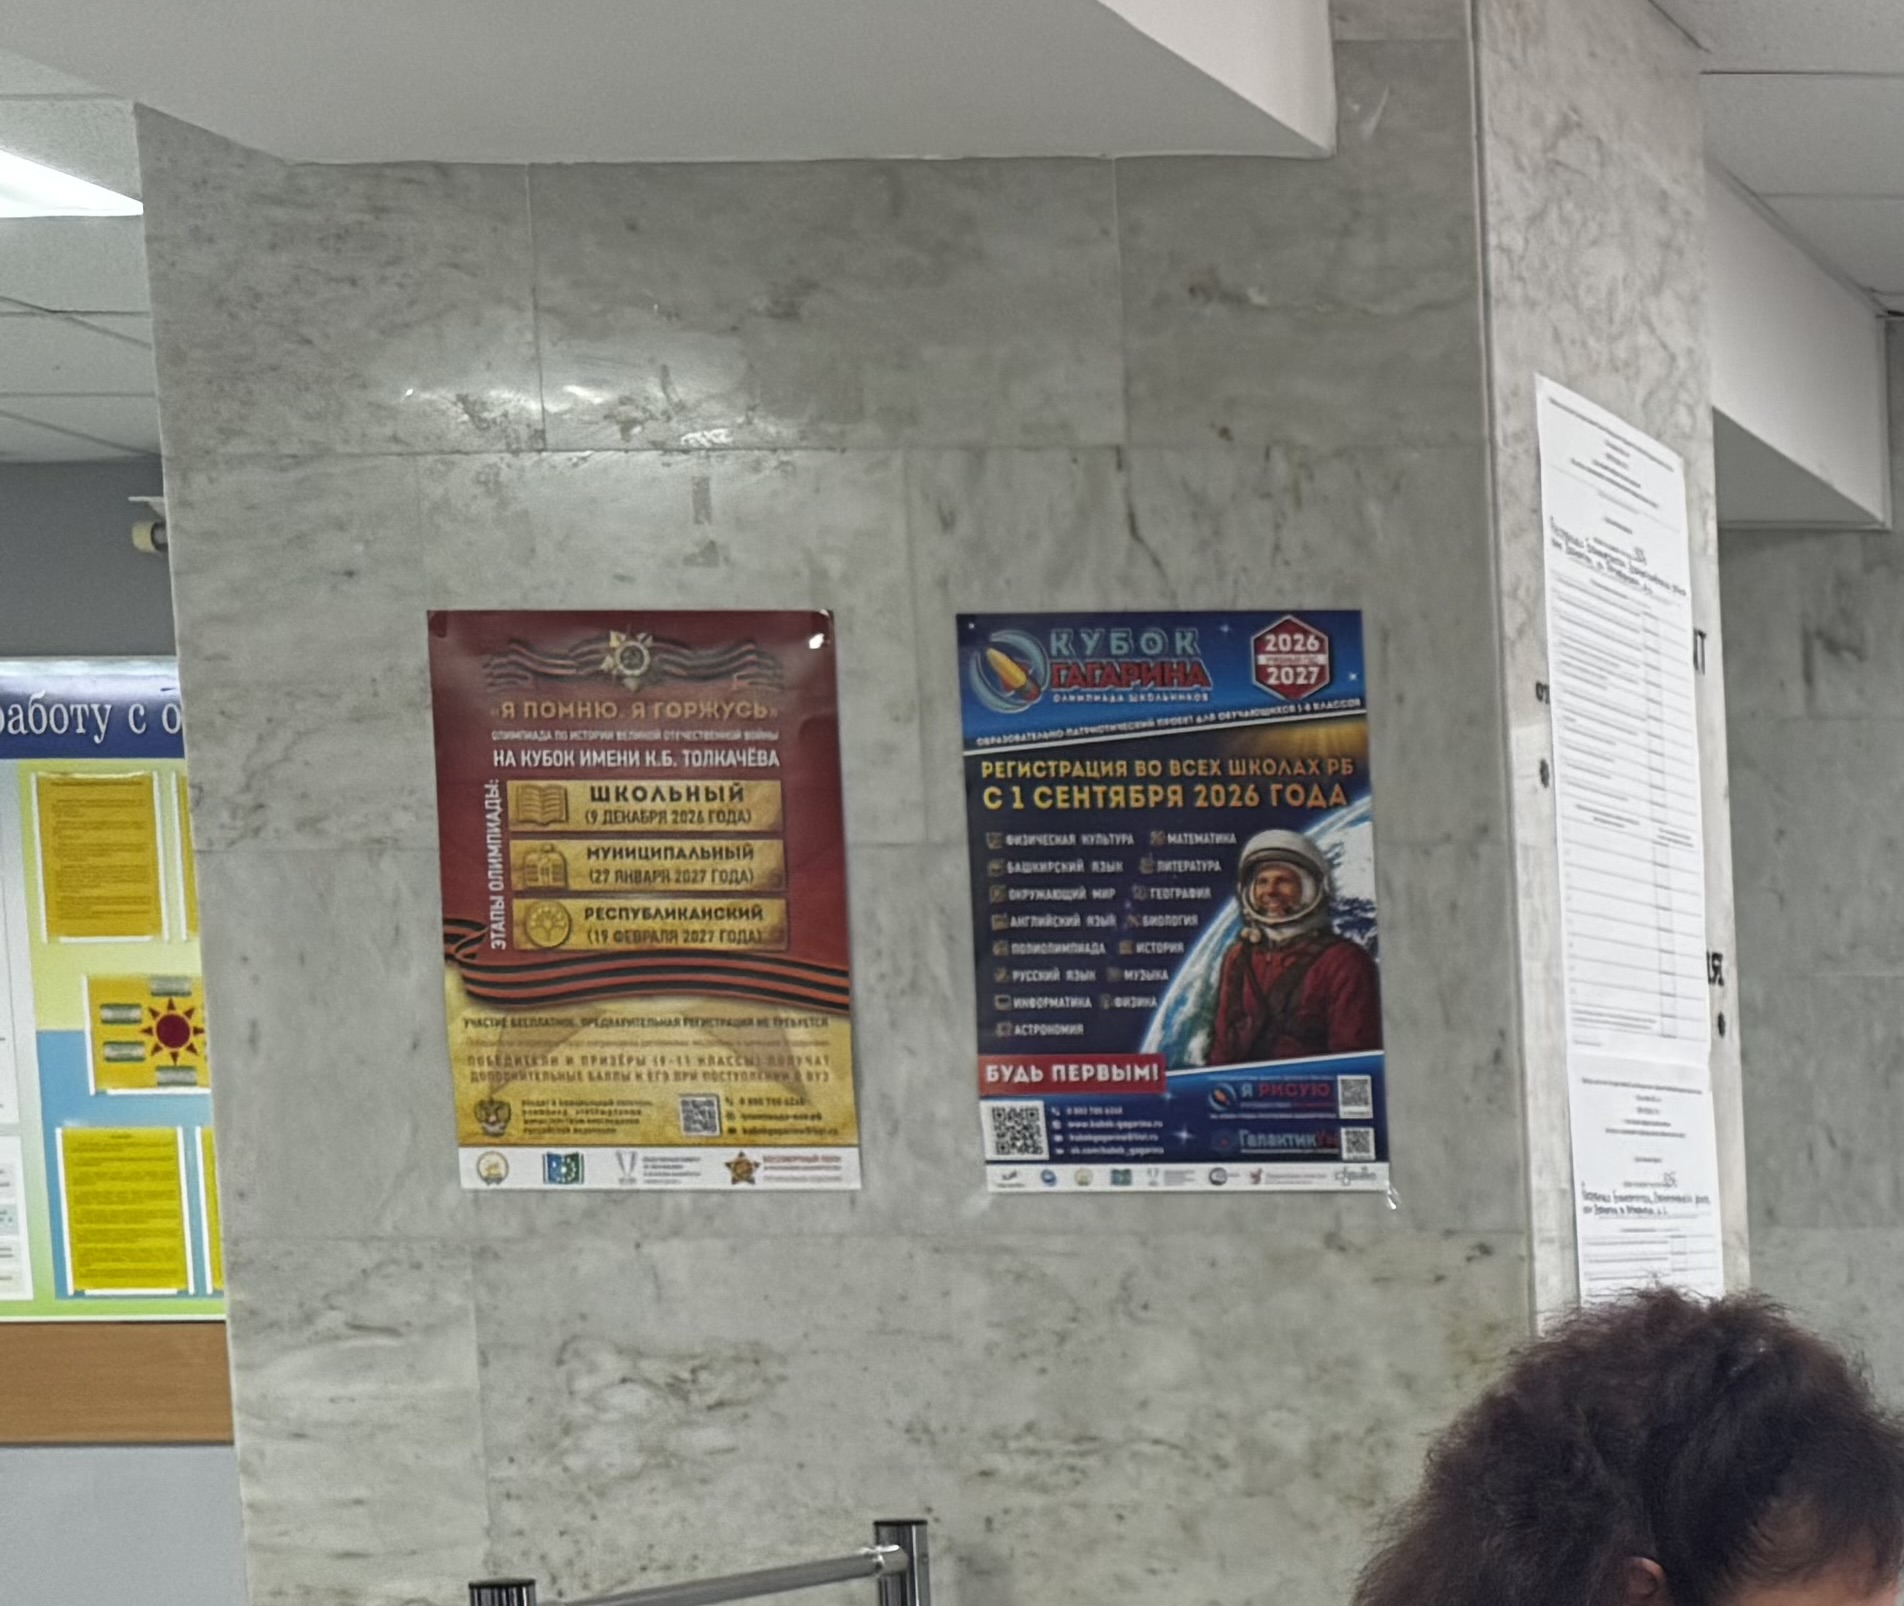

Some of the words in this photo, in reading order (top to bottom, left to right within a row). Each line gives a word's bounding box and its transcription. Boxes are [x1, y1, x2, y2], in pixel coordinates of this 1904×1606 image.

[1050, 628, 1200, 656] КУБОК
[1264, 633, 1319, 652] 2026
[1050, 660, 1212, 690] ГАГАРИНА
[1267, 666, 1319, 685] 2027
[0, 690, 111, 744] аботу
[128, 704, 146, 733] с
[632, 702, 645, 718] Я
[494, 751, 516, 767] НА
[521, 751, 574, 767] КУБОК
[580, 751, 640, 767] ИМЕНИ
[646, 751, 677, 767] К.Б.
[683, 748, 779, 767] ТОЛКАЧЁВА
[981, 760, 1127, 779] РЕГИСТРАЦИЯ
[1136, 760, 1161, 778] ВО
[1169, 759, 1221, 777] ВСЕХ
[1228, 759, 1319, 776] ШКОЛАХ
[1326, 759, 1354, 776] РБ
[590, 782, 744, 802] ШКОЛЬНЫЙ
[983, 786, 1003, 810] С
[1012, 787, 1024, 810] 1
[1033, 785, 1183, 810] СЕНТЯБРЯ
[1194, 784, 1260, 808] 2026
[1270, 784, 1348, 809] ГОДА
[585, 811, 598, 826] (9
[602, 811, 668, 826] ДЕКАБРЯ
[672, 811, 704, 824] 2026
[709, 810, 751, 824] ГОДА)
[484, 780, 505, 892] ОЛИМПИАДЫ:
[1006, 834, 1077, 846] ФИЗИЧЕСКАЯ
[1082, 834, 1134, 846] КУЛЬТУРА
[1167, 833, 1237, 845] МАТЕМАТИКА
[587, 843, 754, 860] МУНИЦИПАЛЬНЫЙ
[1007, 859, 1085, 873] БАШКИРСКИЙ
[1157, 861, 1222, 873] ЛИТЕРАТУРА
[615, 870, 670, 883] ЯНВАРЯ
[675, 870, 706, 883] 2027
[711, 870, 754, 884] ГОДА)
[1092, 888, 1116, 899] МИР
[1150, 887, 1212, 900] ГЕОГРАФИЯ
[584, 904, 763, 921] РЕСПУБЛИКАНСКИЙ
[1142, 915, 1198, 926] БИОЛОГИЯ
[490, 895, 506, 949] ЭТАПЫ
[1010, 914, 1081, 928] АНГЛИЙСКИЙ
[613, 930, 678, 944] ФЕВРАЛЯ
[683, 930, 714, 944] 2027
[720, 930, 762, 945] ГОДА)
[1136, 943, 1184, 953] ИСТОРИЯ
[1012, 968, 1060, 982] РУССКИЙ
[1124, 969, 1169, 981] МУЗЫКА
[1014, 1023, 1084, 1036] АСТРОНОМИЯ
[985, 1066, 1044, 1083] БУДЬ
[1051, 1065, 1159, 1082] ПЕРВЫМ!
[1258, 1082, 1330, 1097] РИСУЮ
